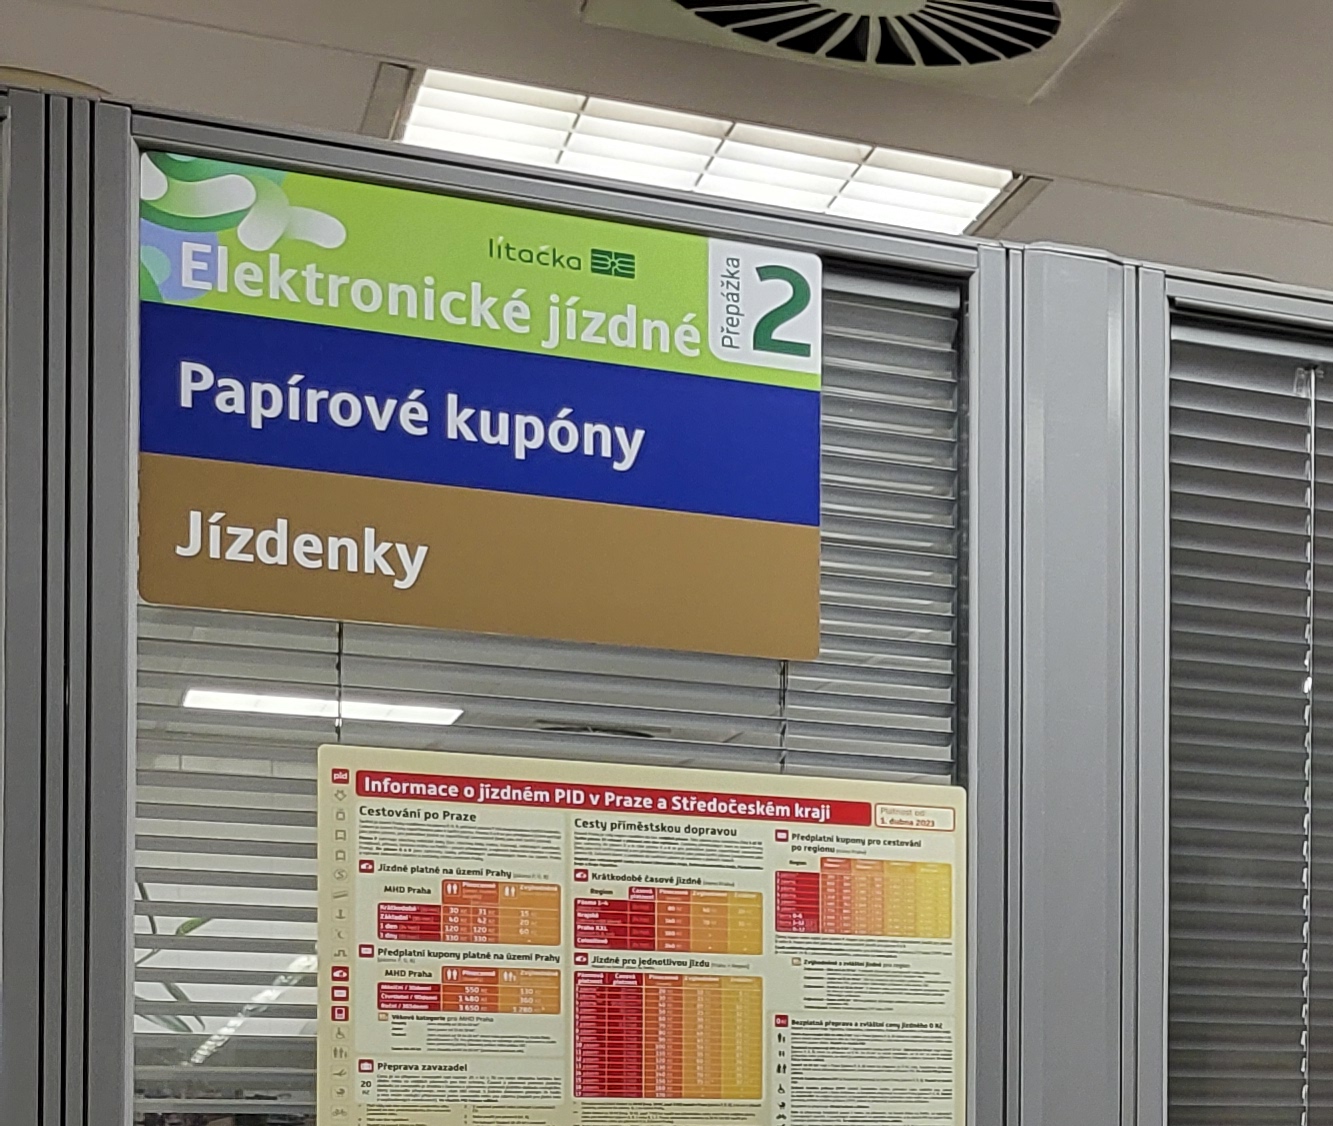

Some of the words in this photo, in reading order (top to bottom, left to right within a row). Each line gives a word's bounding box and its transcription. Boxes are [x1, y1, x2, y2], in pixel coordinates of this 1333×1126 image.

[181, 241, 530, 335] Elektronické
[542, 294, 701, 358] jízdné
[721, 256, 741, 349] Přepážka
[752, 264, 812, 356] 2
[178, 360, 429, 436] Papírové
[446, 394, 645, 471] kupóny
[175, 510, 429, 589] Jízdenky
[359, 806, 421, 820] Cestování
[424, 811, 439, 821] po
[443, 812, 477, 822] Praze
[364, 777, 458, 798] Informace
[464, 787, 474, 798] o
[478, 784, 549, 803] jízdném
[554, 790, 585, 804] PID
[589, 794, 600, 805] v
[605, 792, 652, 808] Praze
[658, 799, 667, 810] a
[671, 795, 790, 817] Středočeském
[795, 803, 831, 822] kraji
[486, 869, 511, 879] Prahy
[377, 1062, 418, 1073] Přeprava
[421, 1063, 467, 1072] zavazadel
